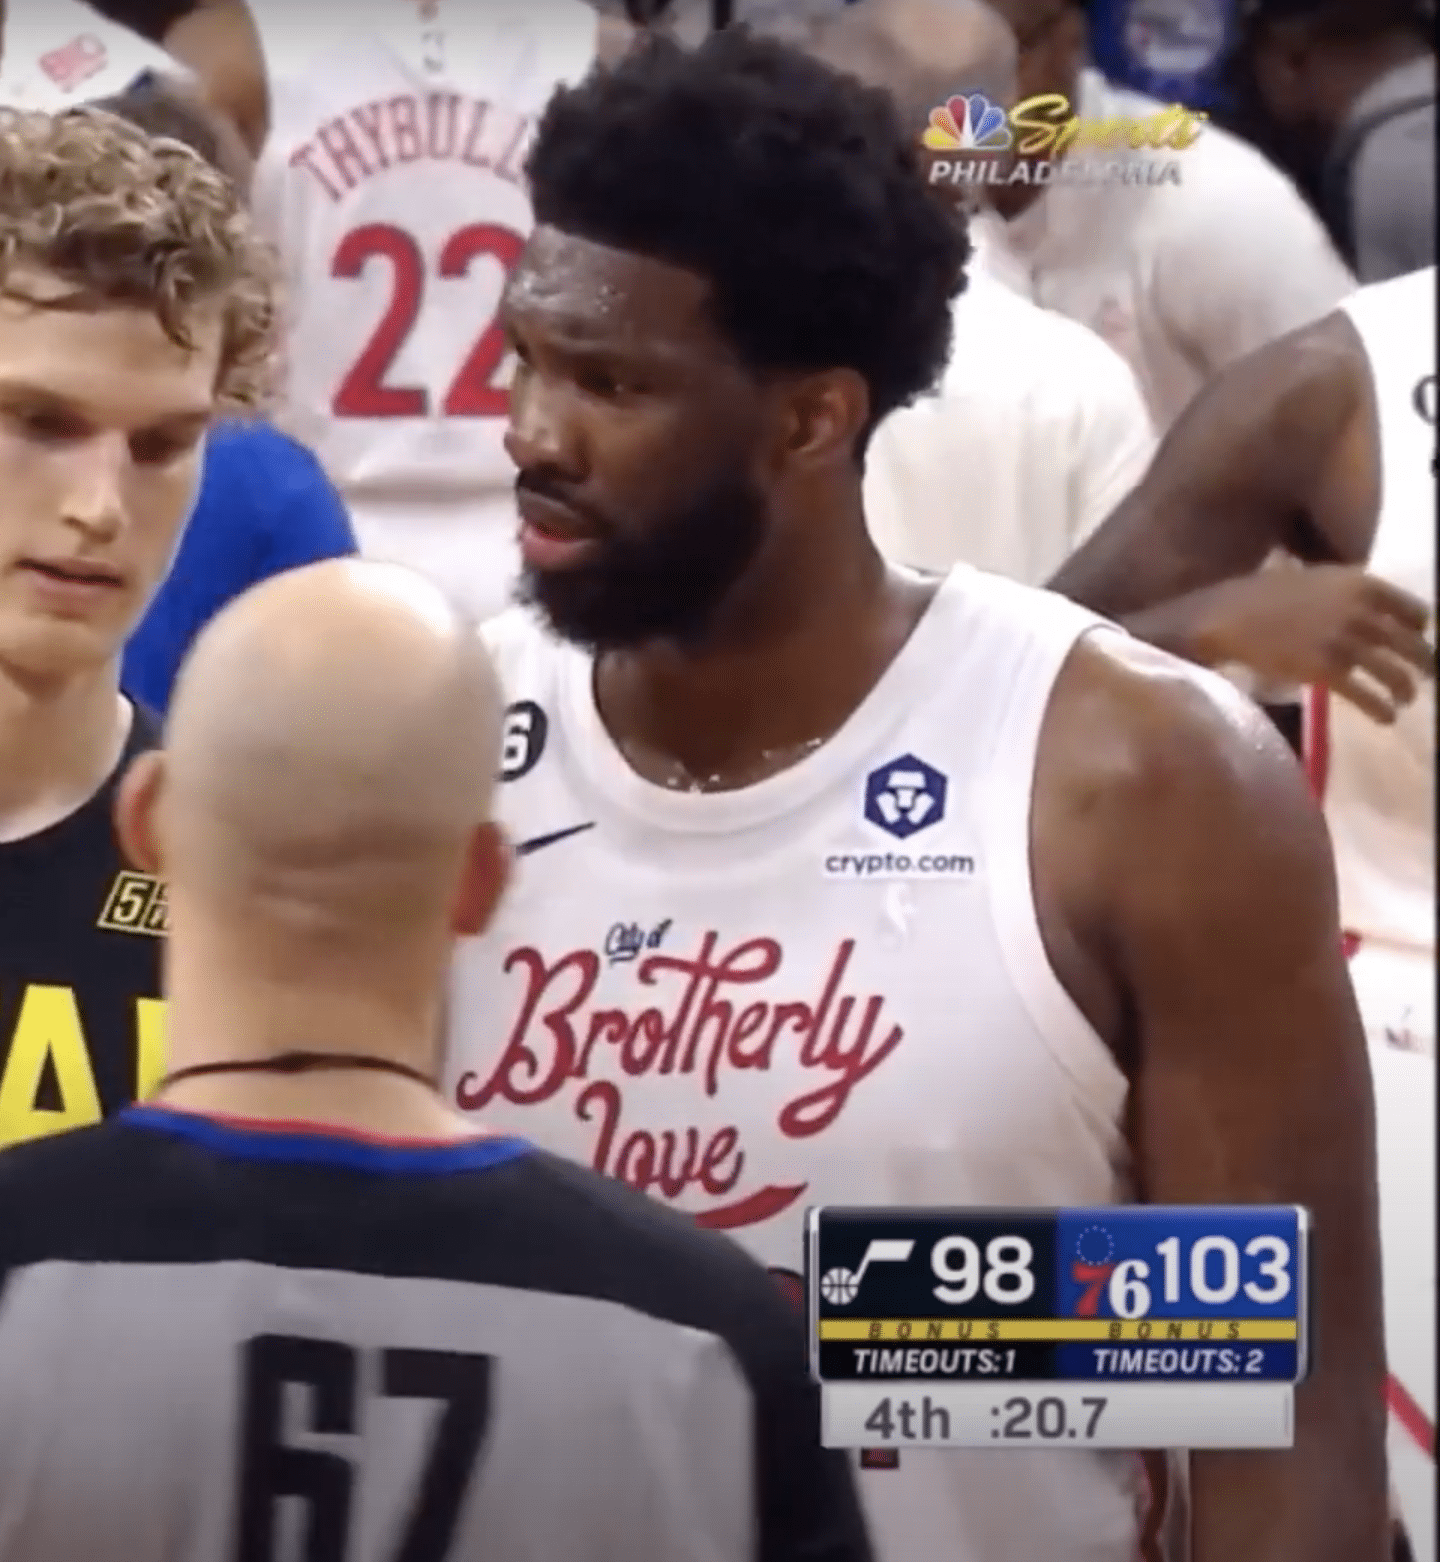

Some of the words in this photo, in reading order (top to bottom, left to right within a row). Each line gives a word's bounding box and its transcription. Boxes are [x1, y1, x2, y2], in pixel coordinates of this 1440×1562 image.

[330, 222, 527, 419] 22
[501, 707, 534, 773] 6
[825, 852, 975, 876] crypto.com
[456, 930, 904, 1139] Brotherly
[238, 1333, 497, 1562] 67
